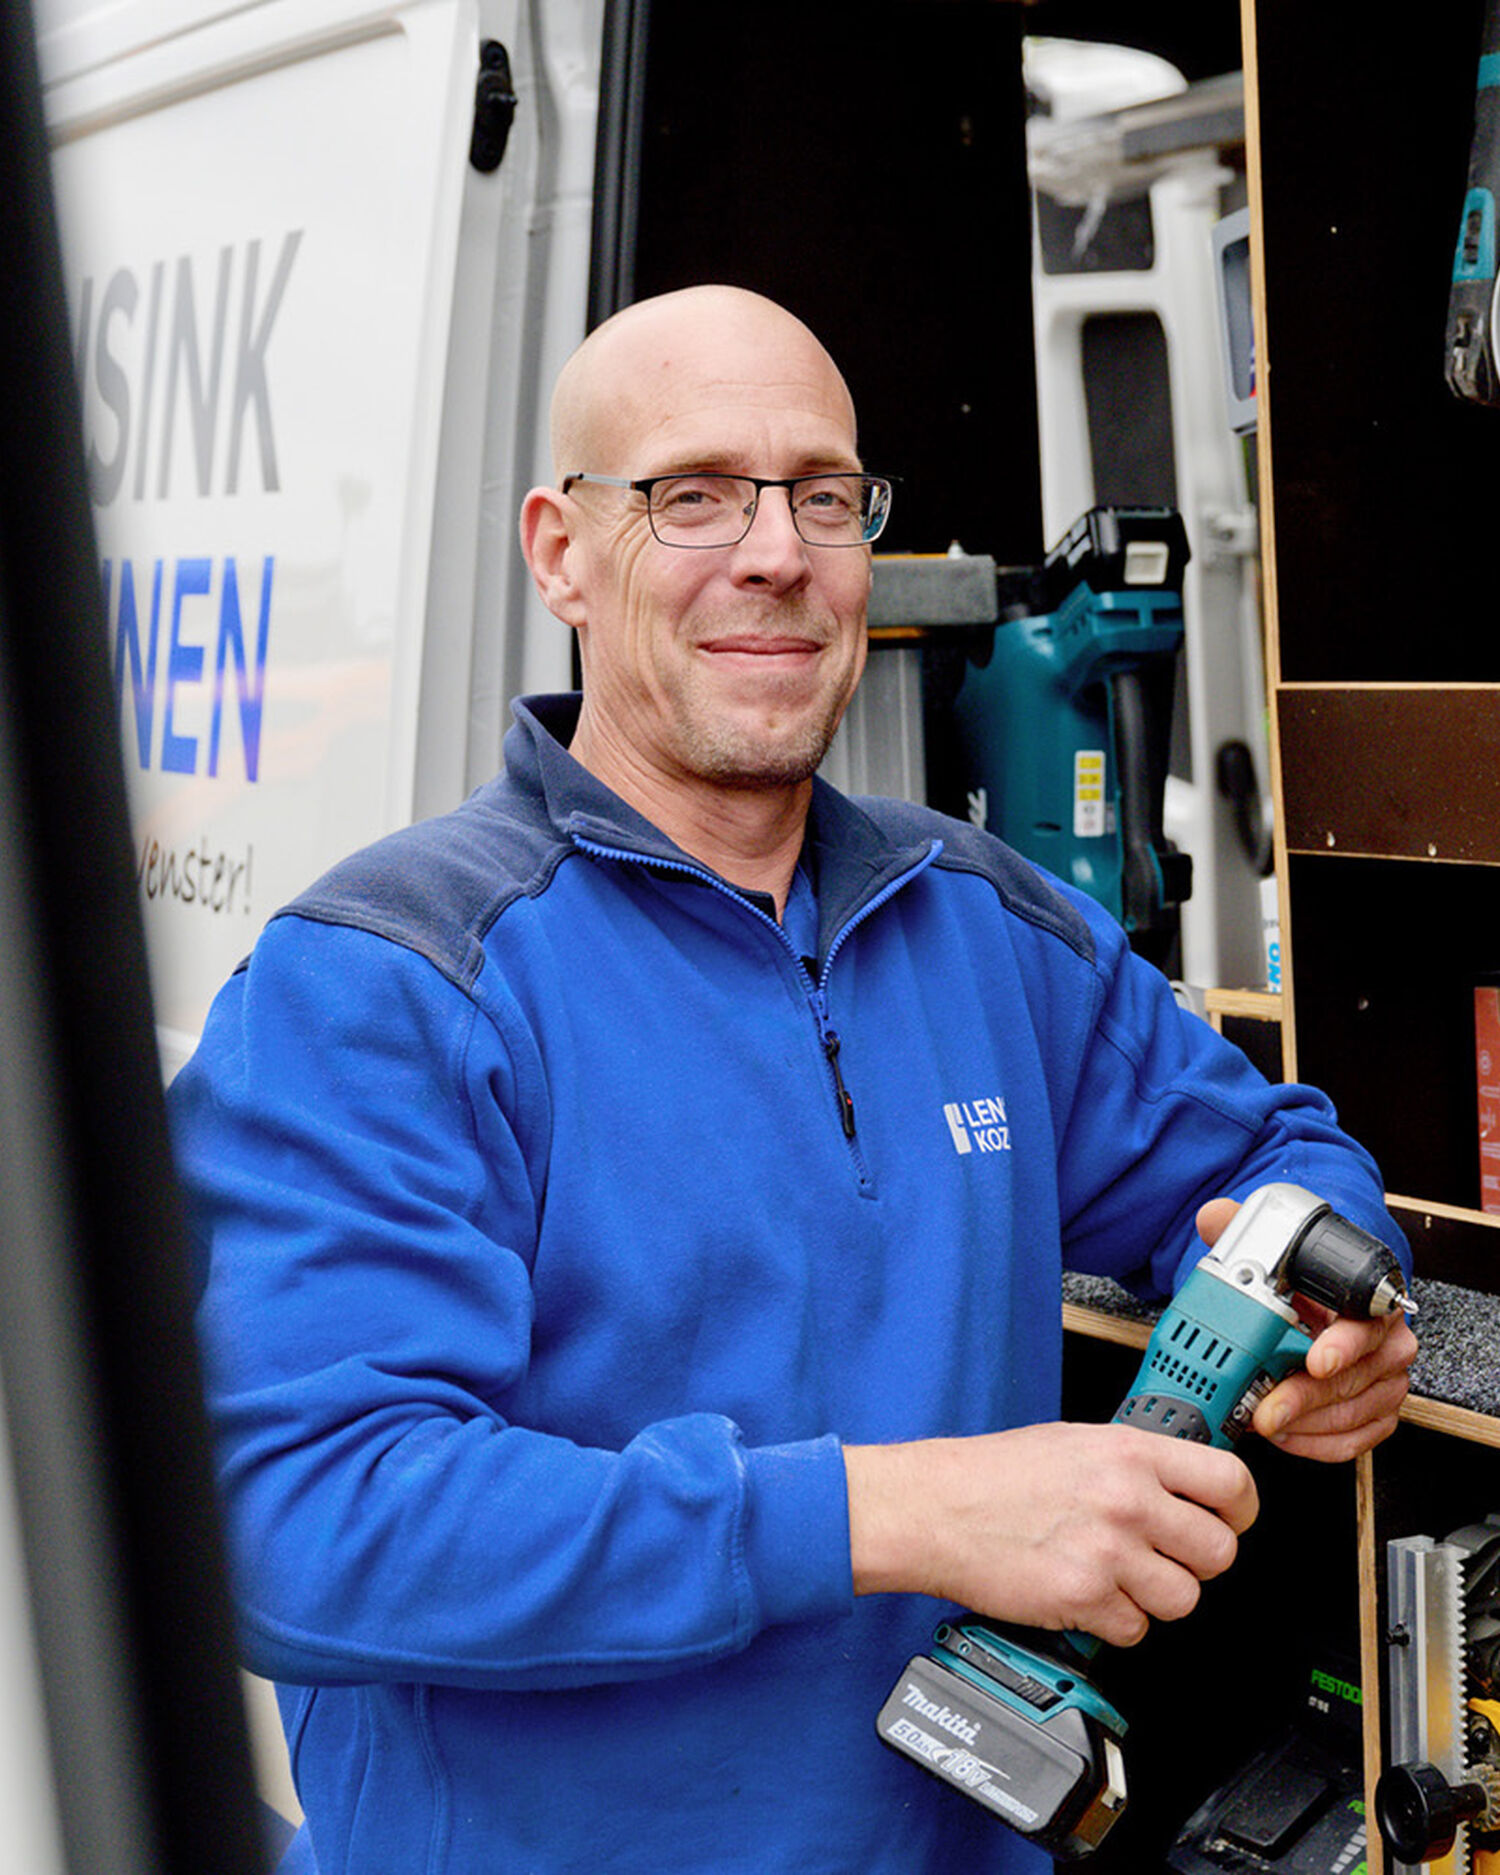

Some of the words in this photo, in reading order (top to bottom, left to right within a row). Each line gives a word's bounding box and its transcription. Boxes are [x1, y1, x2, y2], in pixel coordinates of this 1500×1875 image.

[103, 556, 274, 783] NEN
[961, 1096, 1007, 1128] LEN
[973, 1127, 1012, 1153] KOZ
[1311, 1668, 1363, 1706] FESTOO
